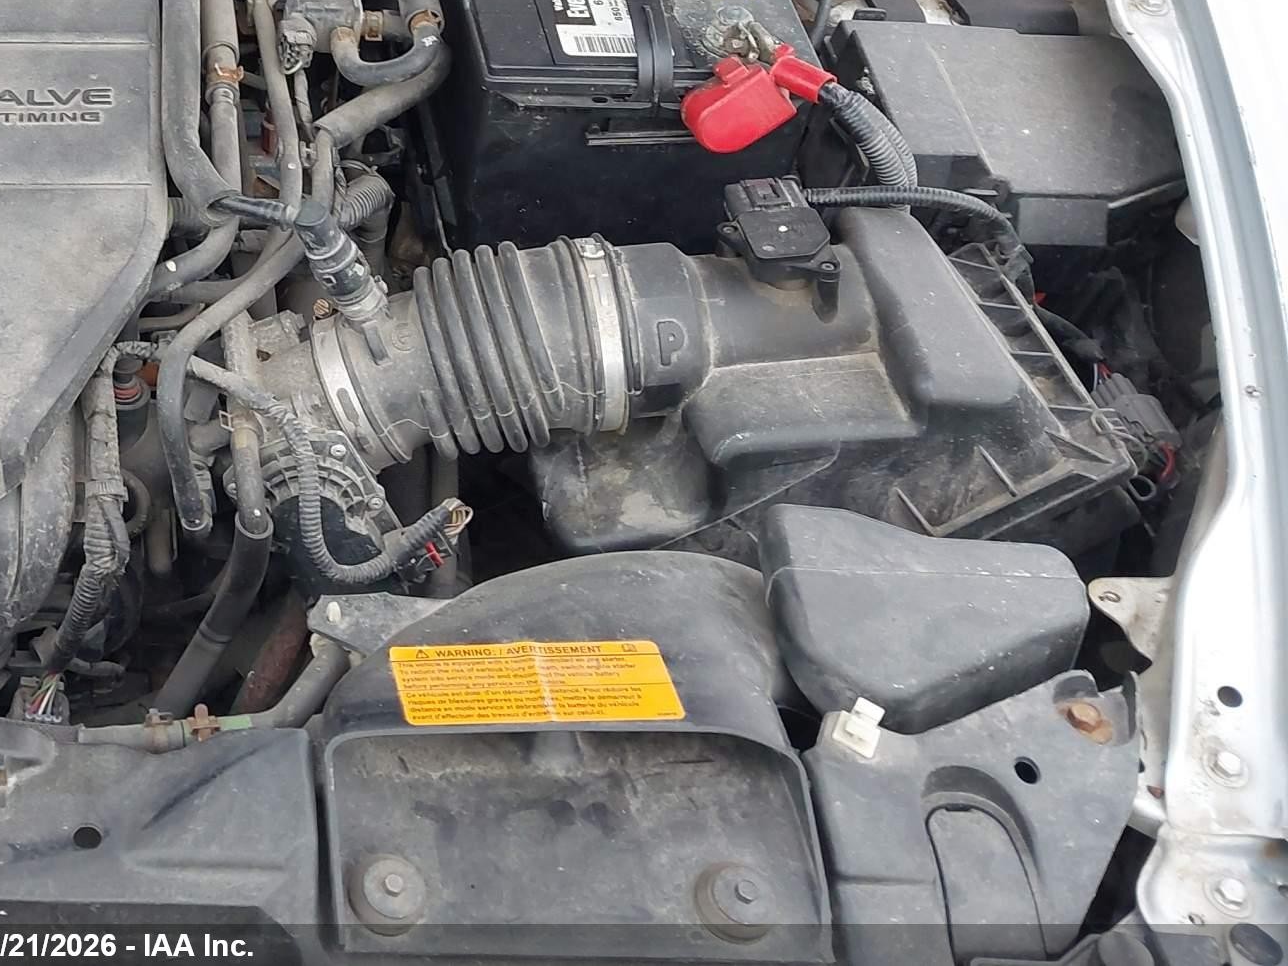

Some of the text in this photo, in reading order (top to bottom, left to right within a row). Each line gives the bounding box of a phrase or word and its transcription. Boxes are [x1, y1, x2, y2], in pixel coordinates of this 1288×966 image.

[0, 110, 101, 124] TIMING
[656, 320, 686, 367] P
[505, 644, 602, 655] AVERTISSEMENT
